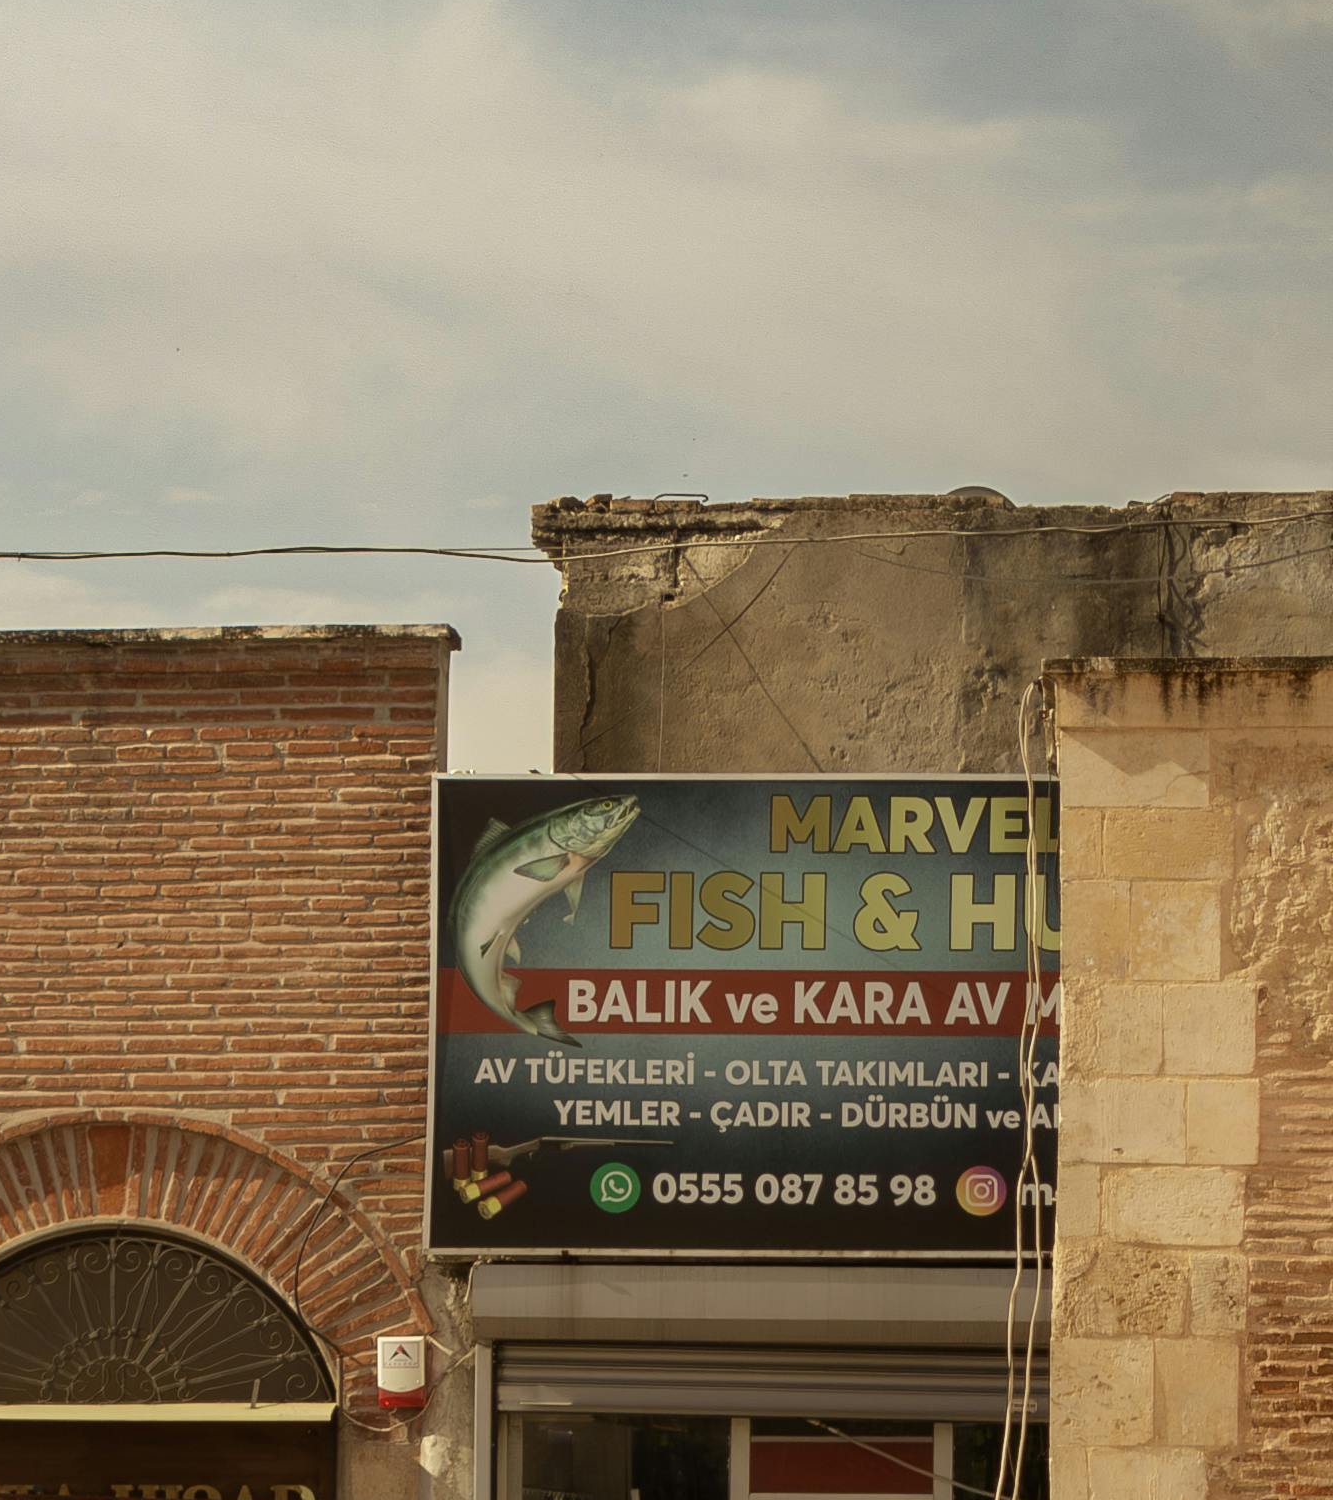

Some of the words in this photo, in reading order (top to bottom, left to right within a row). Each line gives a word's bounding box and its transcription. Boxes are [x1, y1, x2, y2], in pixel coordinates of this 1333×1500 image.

[609, 871, 828, 951] FISH
[853, 871, 923, 952] &
[568, 979, 712, 1024] BALIK
[724, 993, 779, 1025] ve
[794, 980, 931, 1025] KARA
[943, 981, 1011, 1025] AV
[474, 1058, 517, 1084] AV
[525, 1050, 695, 1085] TÜFEKLERİ
[725, 1060, 808, 1086] OLTA
[816, 1061, 989, 1087] TAKIMLARI
[553, 1100, 680, 1126] YEMLER
[710, 1101, 811, 1132] ÇADIR
[841, 1095, 977, 1129] DÜRBÜN
[986, 1110, 1021, 1129] ve
[652, 1172, 744, 1204] 0555
[755, 1173, 823, 1205] 087
[834, 1174, 879, 1206] 85
[890, 1174, 936, 1206] 98
